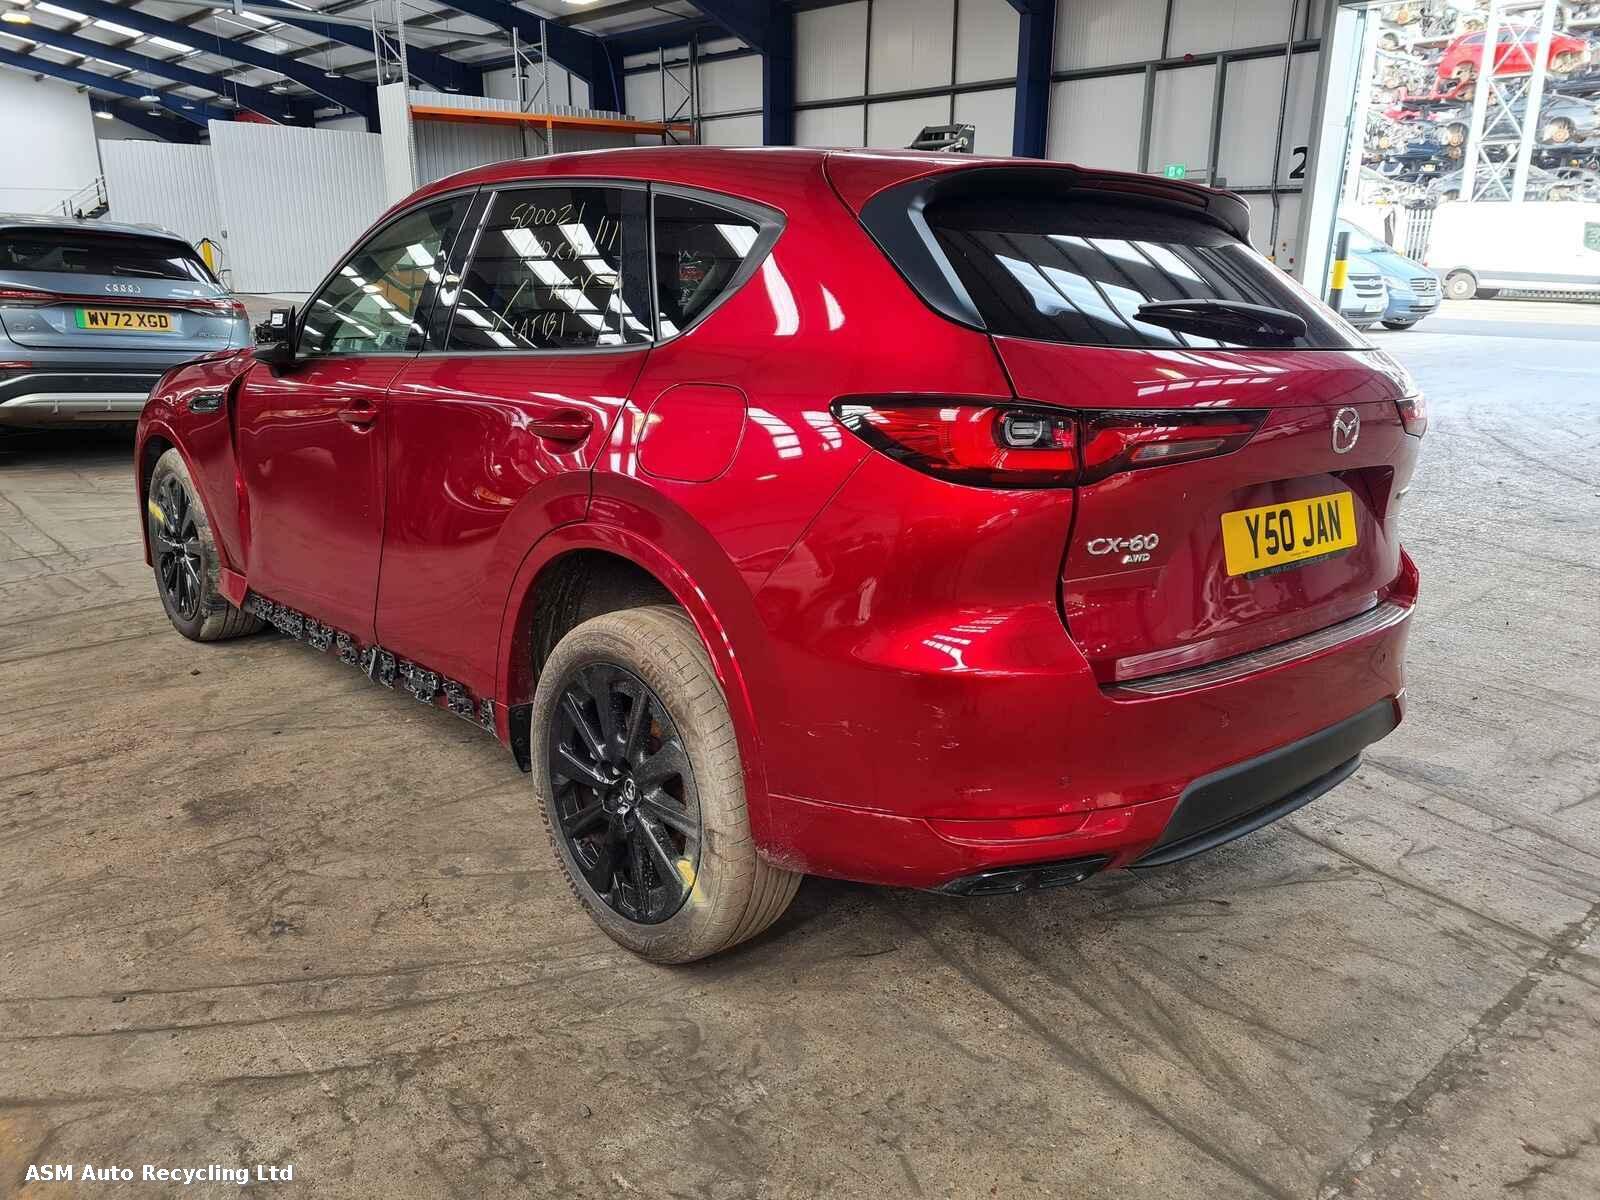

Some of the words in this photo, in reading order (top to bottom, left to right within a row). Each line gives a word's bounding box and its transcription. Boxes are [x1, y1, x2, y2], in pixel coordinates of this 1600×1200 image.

[1289, 147, 1308, 179] 2
[87, 311, 133, 326] WV72
[138, 313, 169, 328] XGD
[1244, 508, 1294, 559] Y50
[1302, 499, 1342, 548] JAN
[1086, 533, 1160, 555] CX-60
[1121, 553, 1151, 564] AWD
